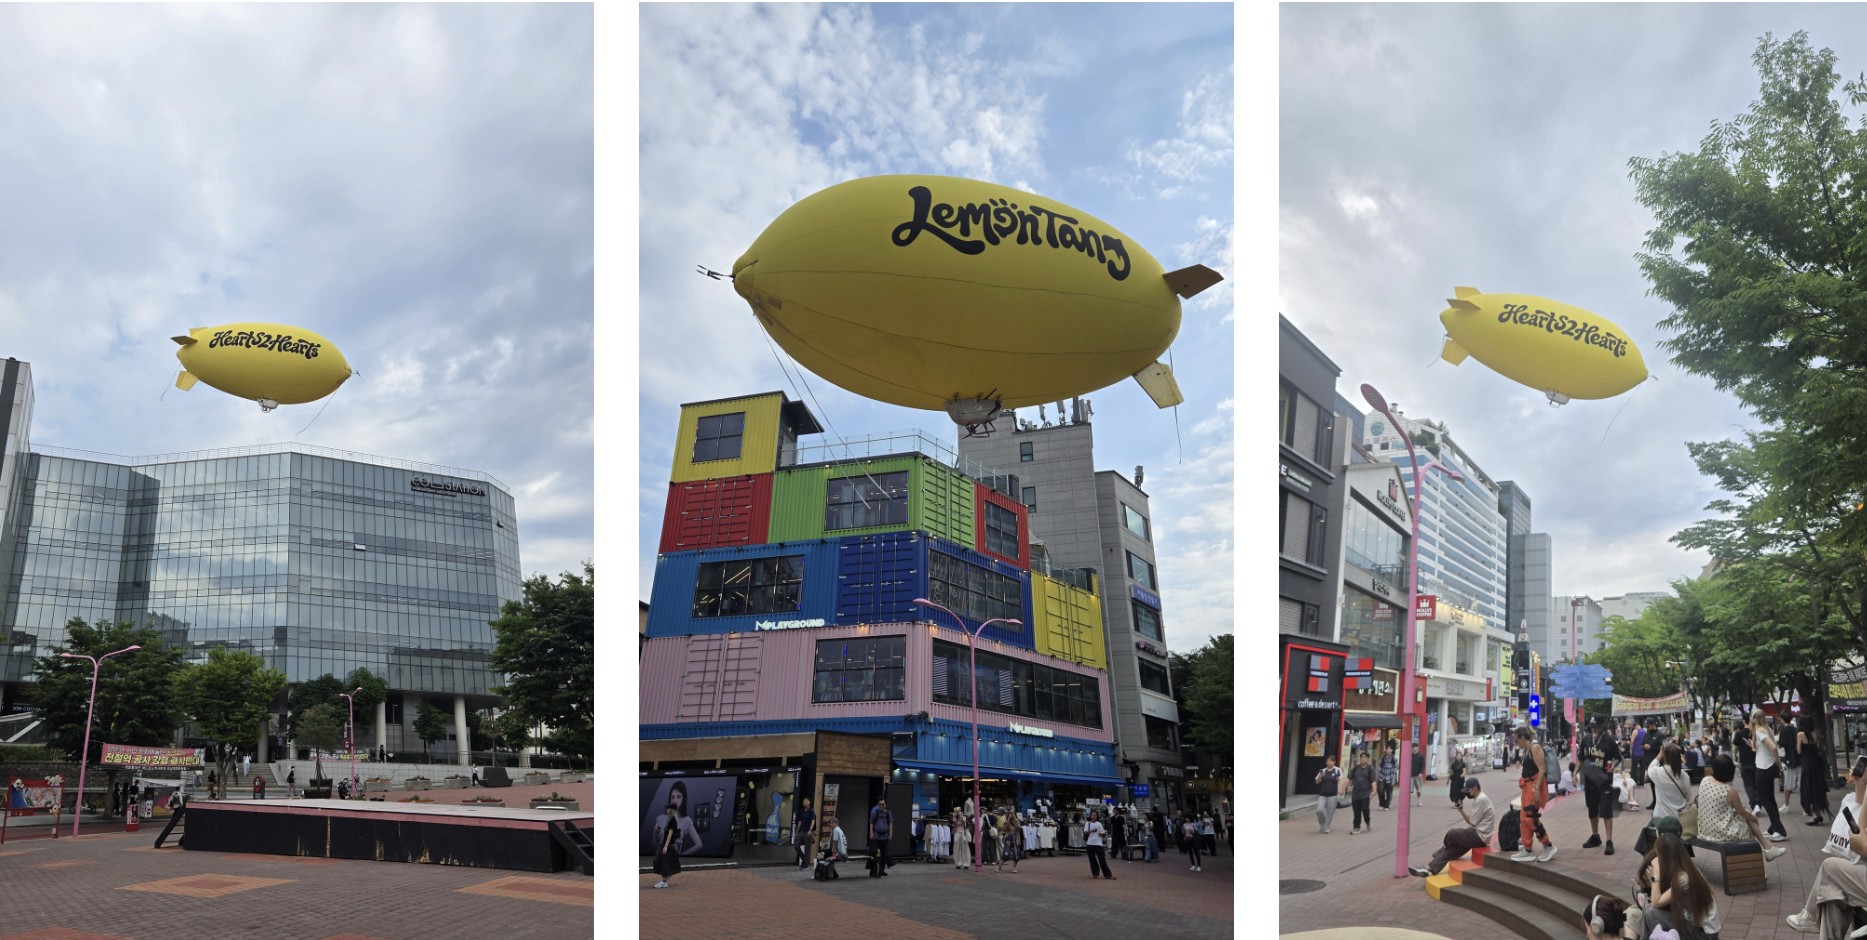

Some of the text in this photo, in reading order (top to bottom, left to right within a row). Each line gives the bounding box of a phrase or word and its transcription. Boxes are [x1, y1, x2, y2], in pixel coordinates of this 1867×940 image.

[209, 330, 321, 359] Hearts2Hearts
[1497, 304, 1627, 358] Hearts2Hearts
[1297, 698, 1314, 708] coffee
